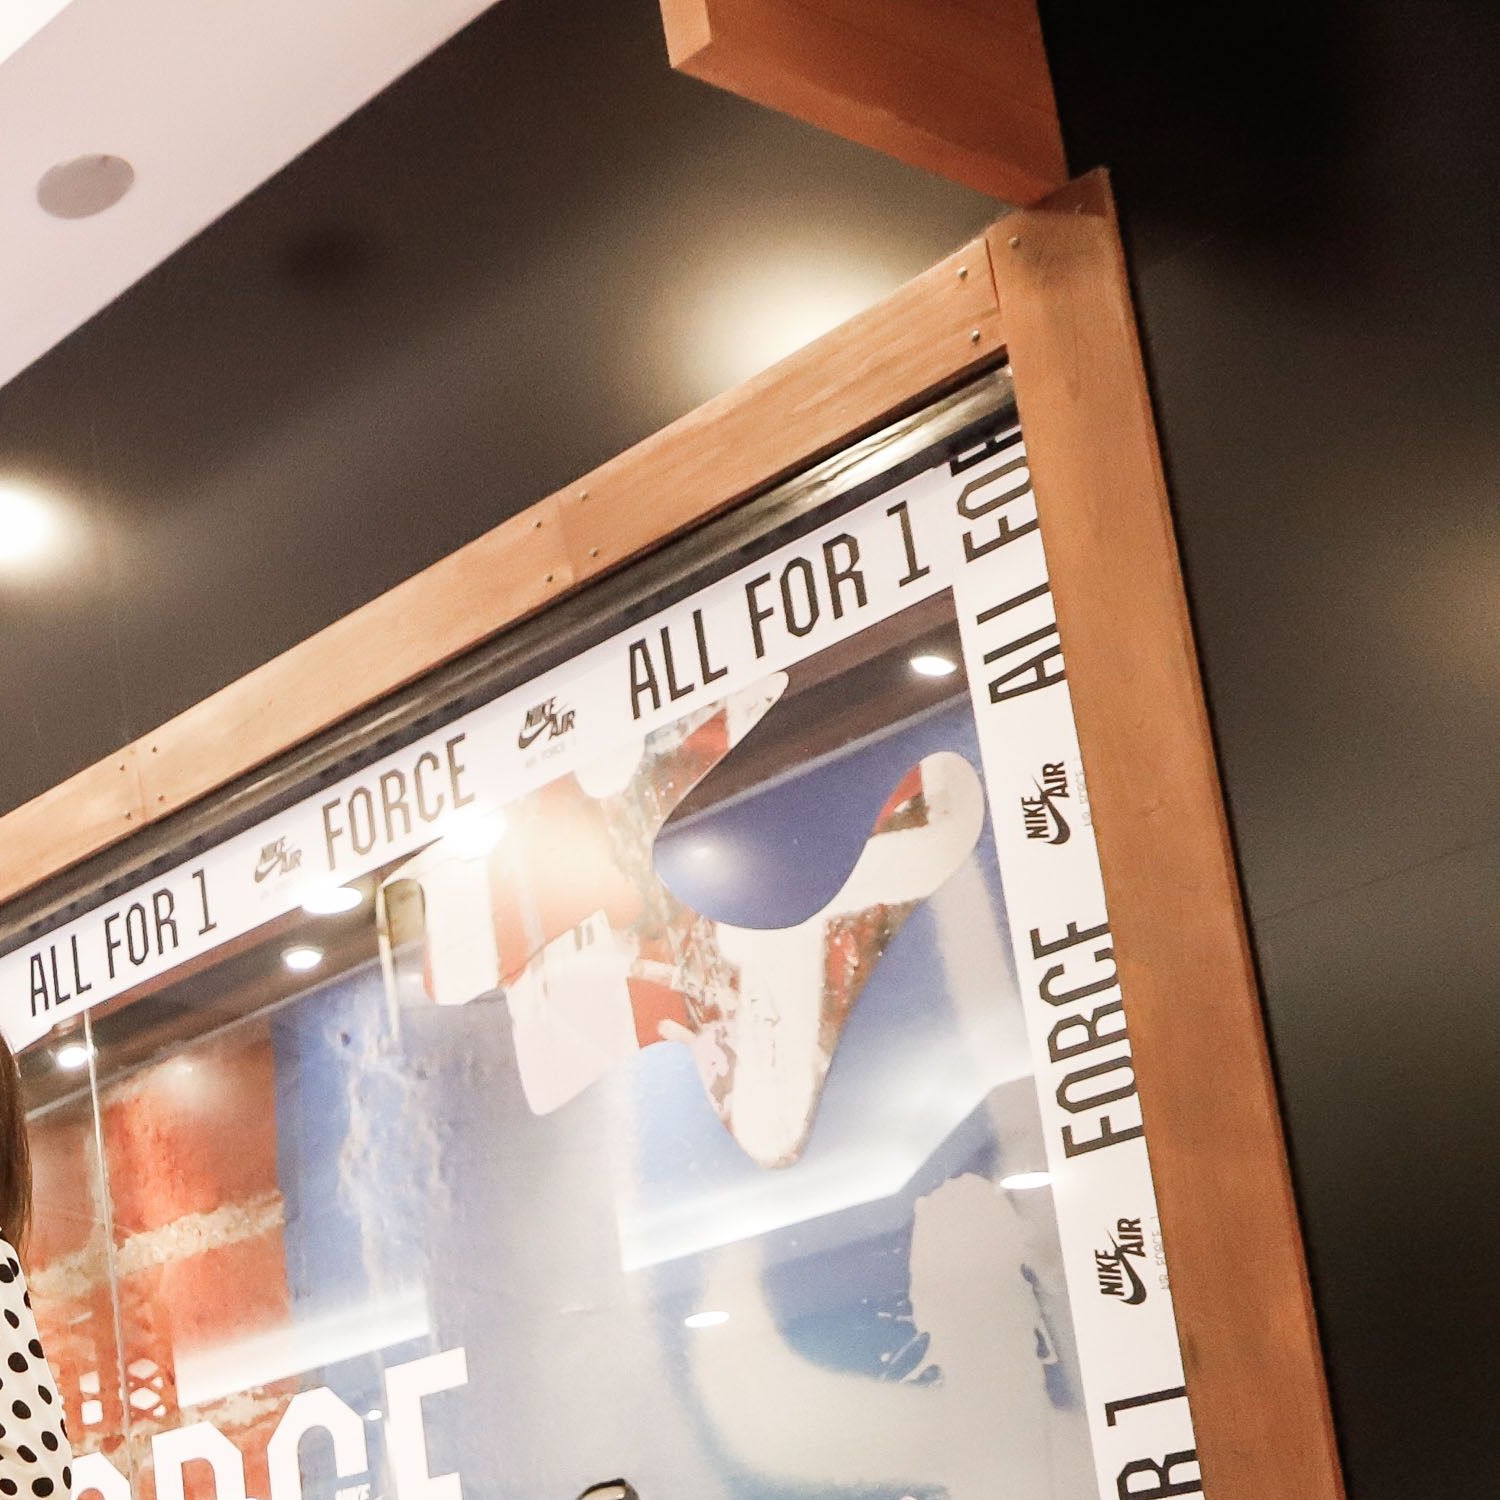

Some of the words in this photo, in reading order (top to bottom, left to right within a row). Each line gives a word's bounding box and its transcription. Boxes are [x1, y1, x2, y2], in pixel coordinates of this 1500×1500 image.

[629, 608, 729, 720] ALL
[745, 532, 868, 659] FOR
[887, 500, 931, 588] 1
[525, 695, 557, 728] NIKE
[549, 708, 577, 741] AIR
[1042, 760, 1070, 799] AIR
[322, 732, 476, 872] FORCE
[1021, 795, 1050, 839] NIKE
[30, 934, 92, 1018] ALL
[104, 887, 179, 980] FOR
[192, 866, 217, 936] 1
[1117, 1217, 1147, 1258] AIR
[1095, 1248, 1125, 1298] NIKE
